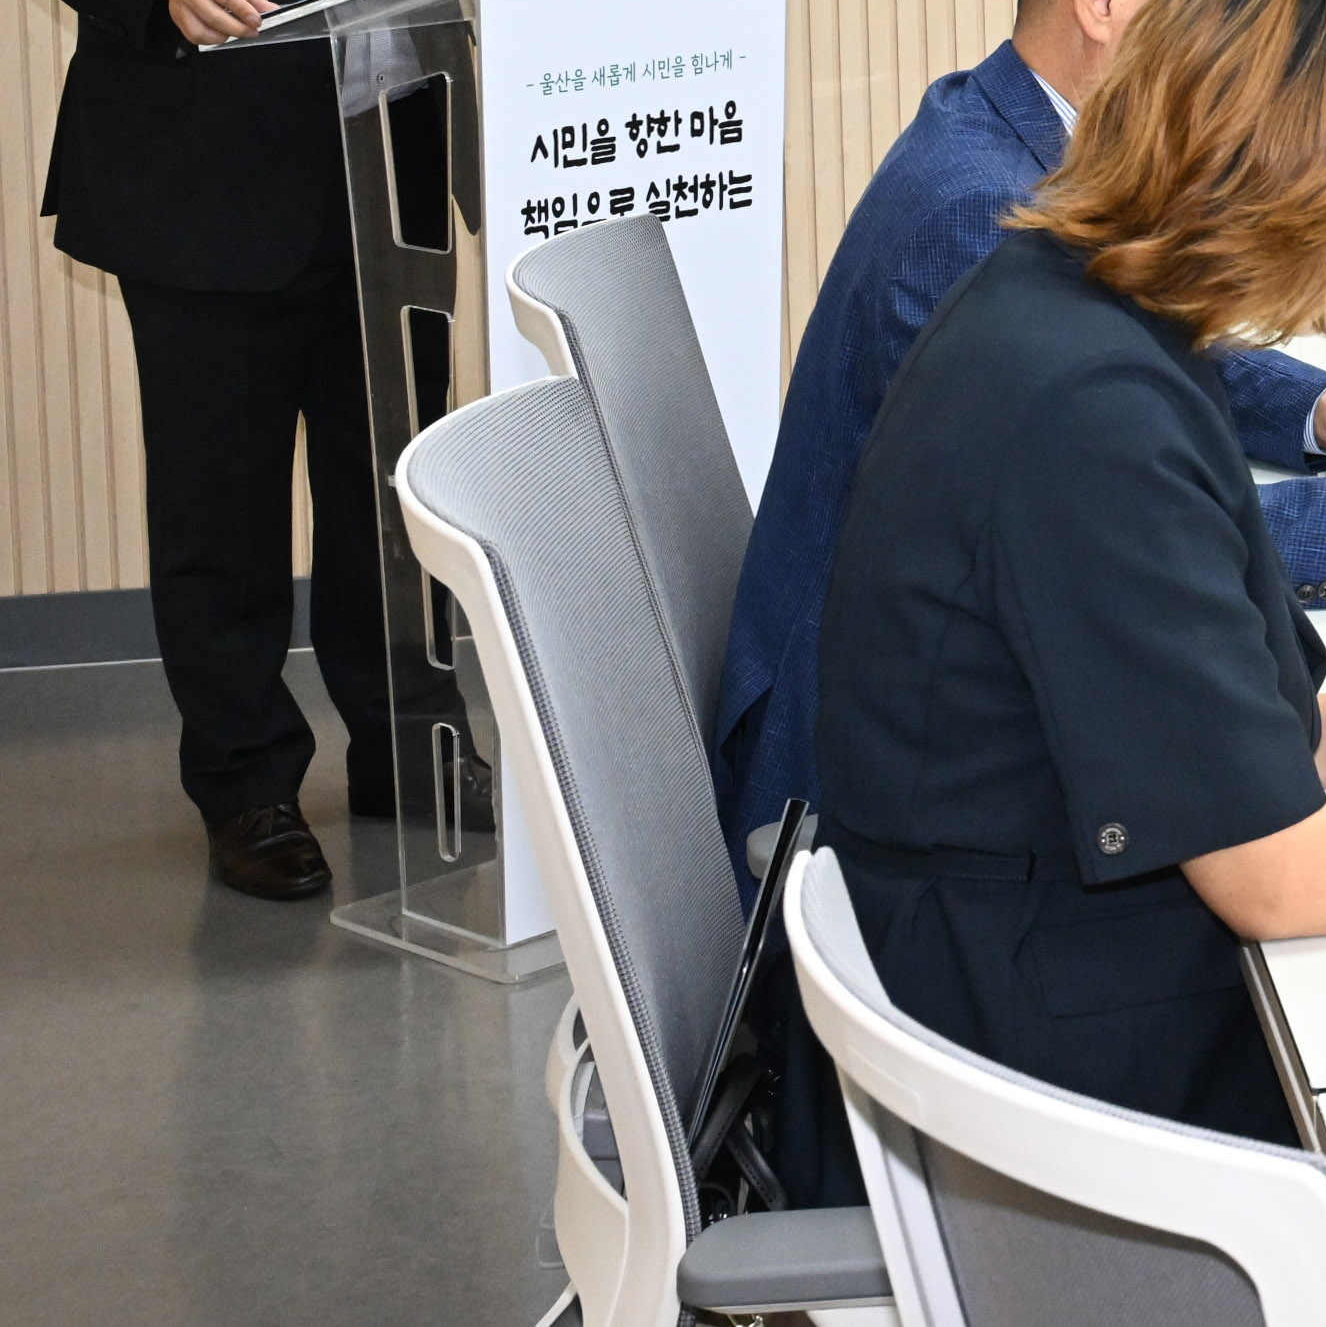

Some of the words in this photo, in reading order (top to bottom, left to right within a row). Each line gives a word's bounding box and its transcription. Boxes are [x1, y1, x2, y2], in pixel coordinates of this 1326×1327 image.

[539, 68, 587, 96] 울산을
[591, 61, 636, 87] 새롭게
[642, 55, 686, 81] 시민을
[691, 49, 733, 74] 힘나게
[530, 118, 616, 168] 시민을
[624, 109, 682, 159] 향한
[690, 100, 743, 145] 마음
[520, 186, 635, 239] 책임으로
[645, 170, 753, 222] 실천하는
